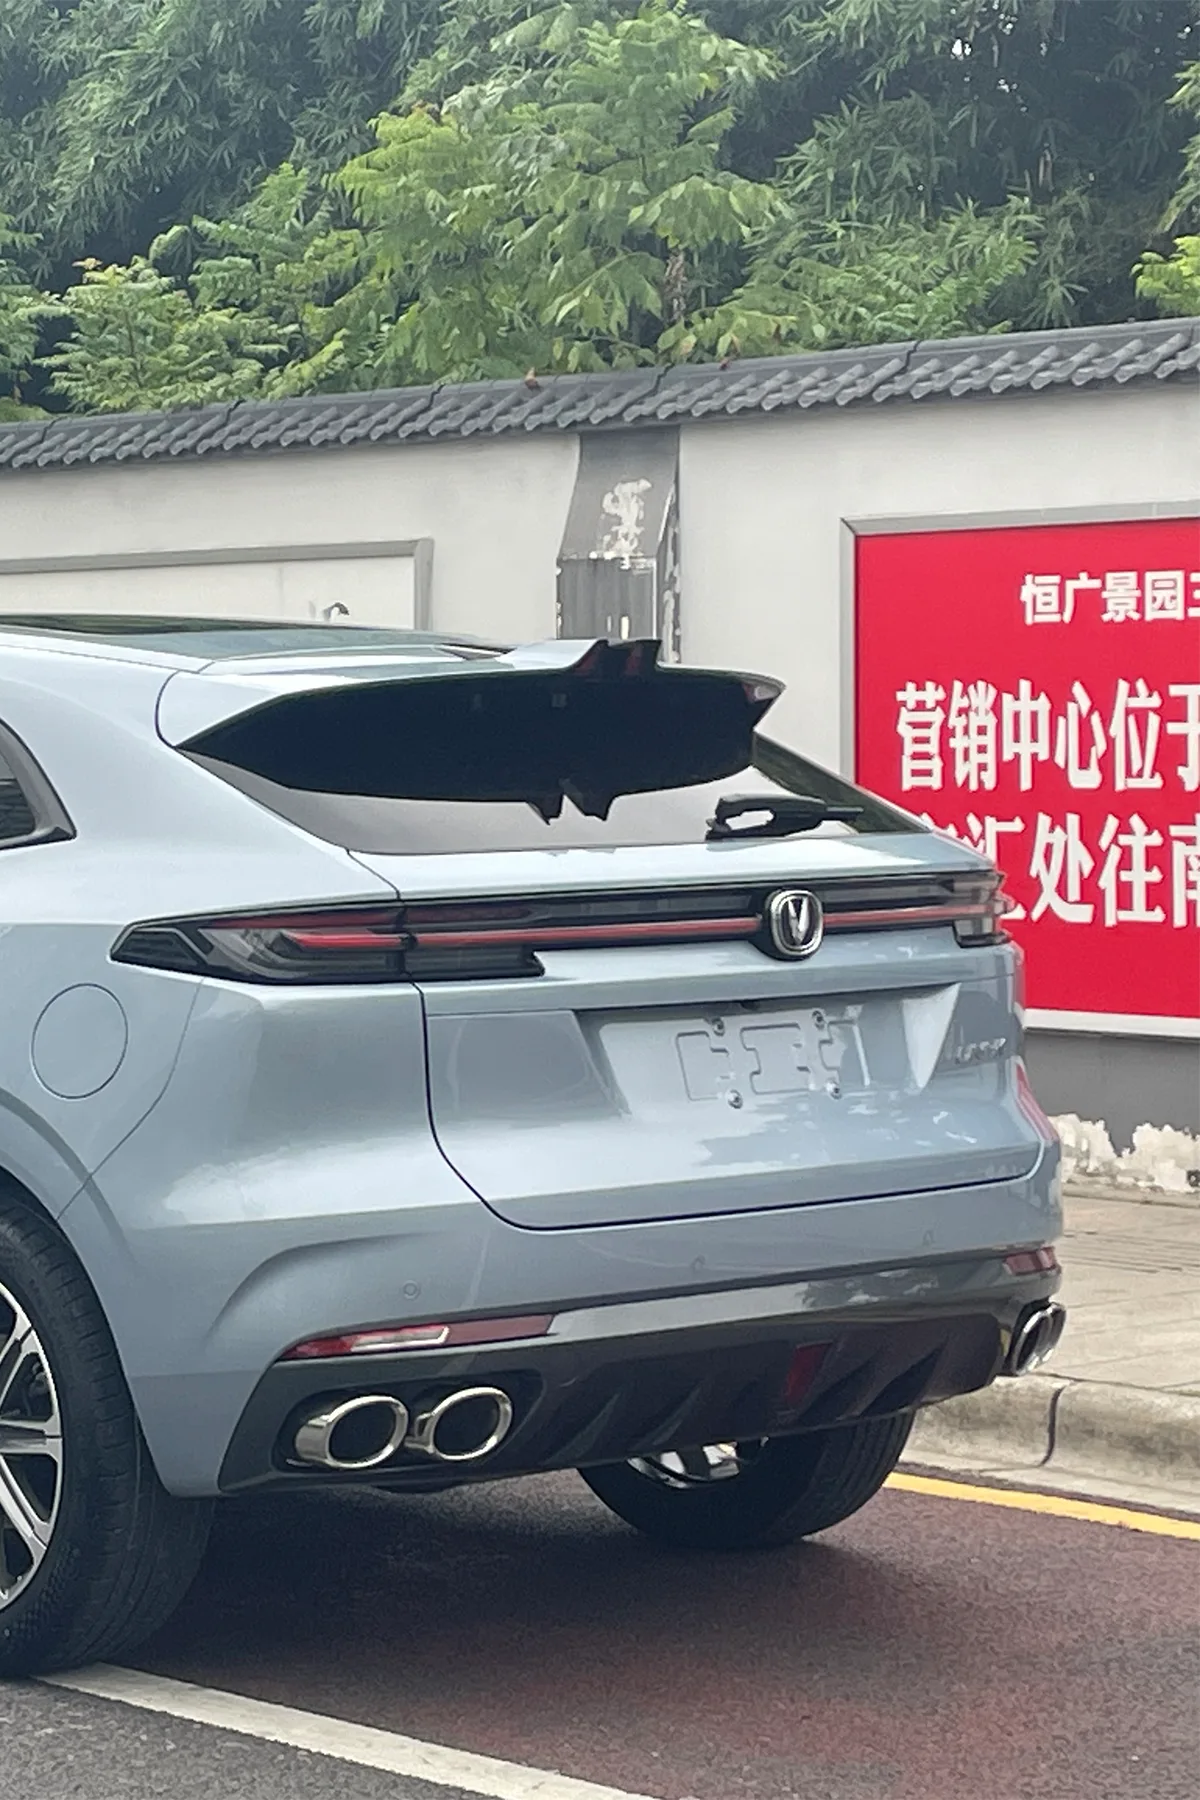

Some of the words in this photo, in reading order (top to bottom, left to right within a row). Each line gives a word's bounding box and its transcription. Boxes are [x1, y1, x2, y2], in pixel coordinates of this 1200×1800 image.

[1020, 570, 1200, 626] 恒广景园
[894, 676, 1200, 793] 营销中心位于
[919, 811, 1200, 928] 汇处往
